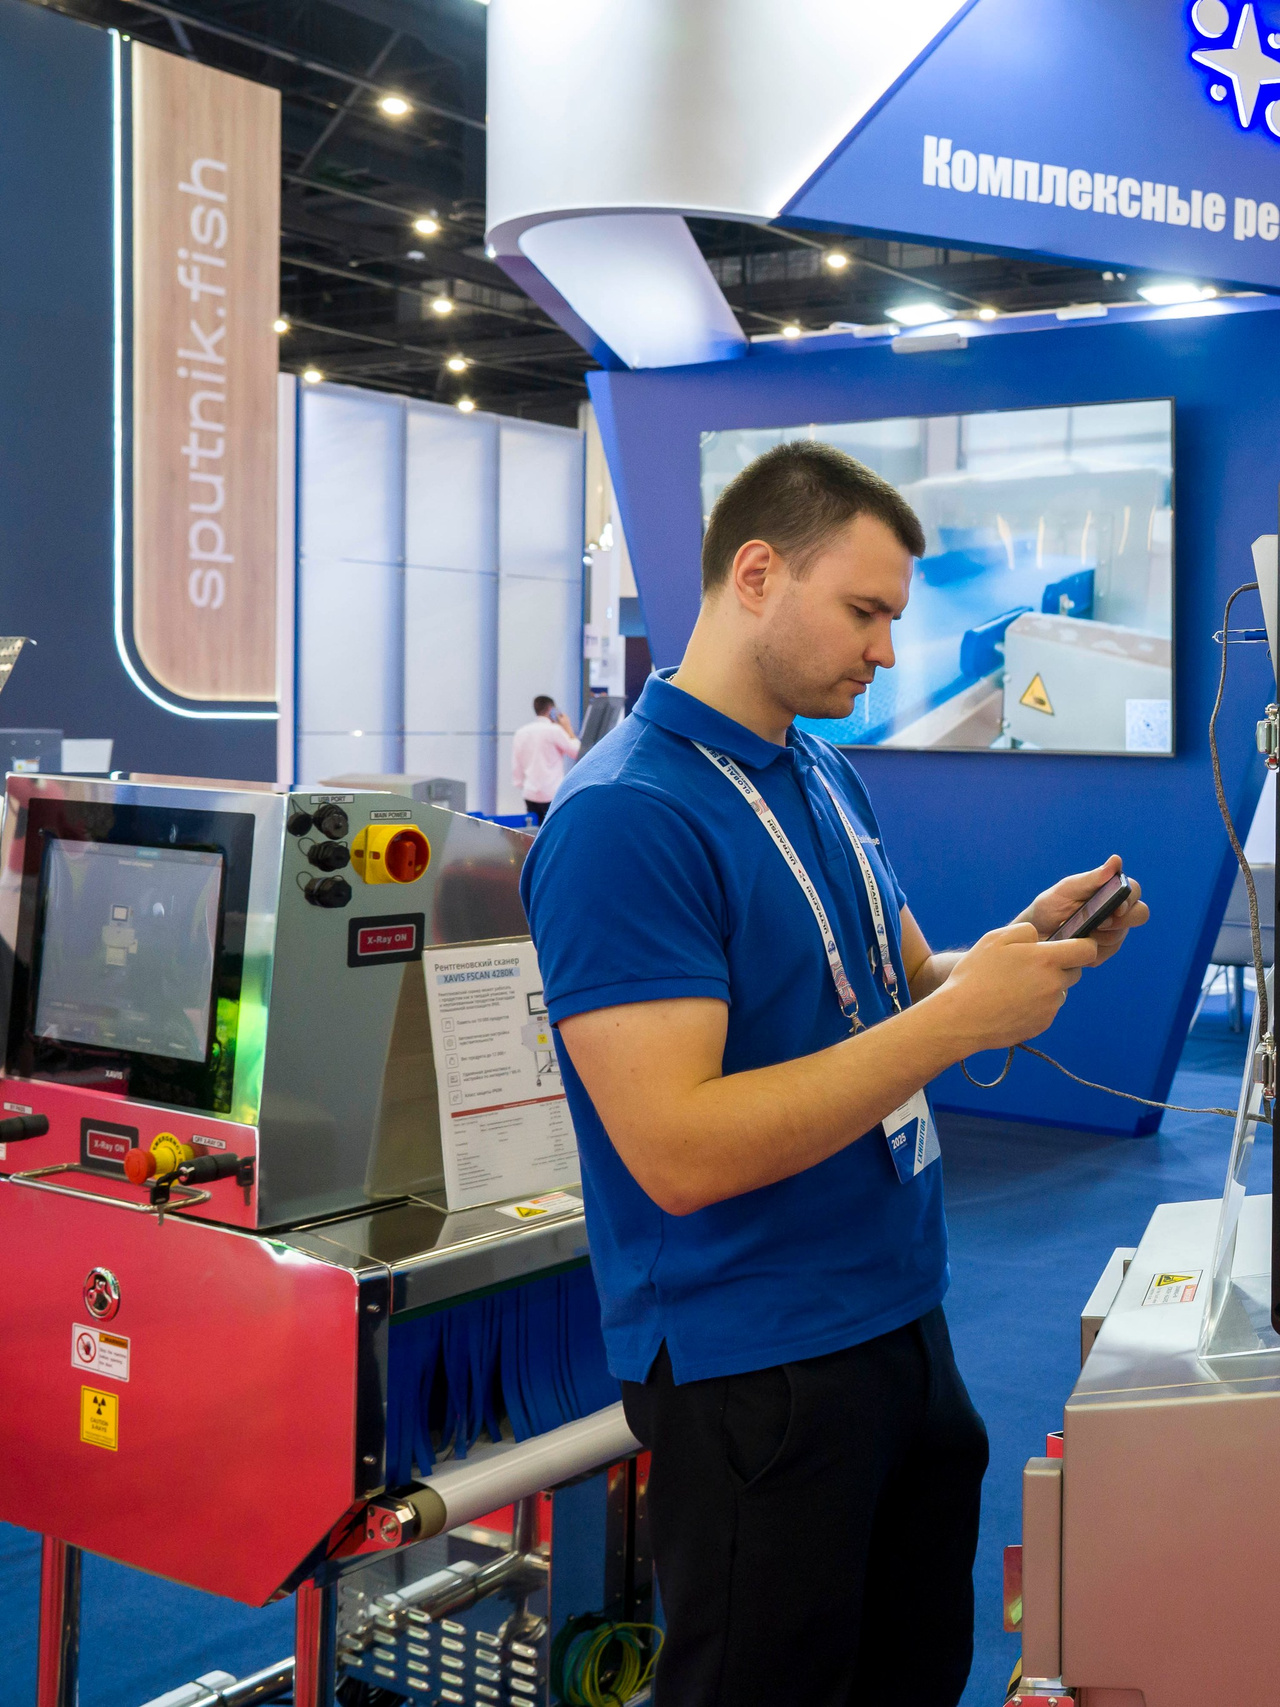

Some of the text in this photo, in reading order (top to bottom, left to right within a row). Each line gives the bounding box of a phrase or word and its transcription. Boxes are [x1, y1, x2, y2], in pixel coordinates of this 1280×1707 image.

[923, 135, 1226, 232] Комплексные
[178, 156, 234, 610] sputnik.fish
[727, 766, 751, 795] GLOBAL
[866, 869, 880, 917] ULTRAFISH
[367, 934, 407, 945] X-Ray ON
[434, 957, 520, 972] Рентгеновский сканер
[443, 973, 465, 983] XAVIS
[94, 1139, 125, 1154] X-Ray ON
[891, 1132, 907, 1150] 2025
[917, 1118, 926, 1164] EXHIBITOR
